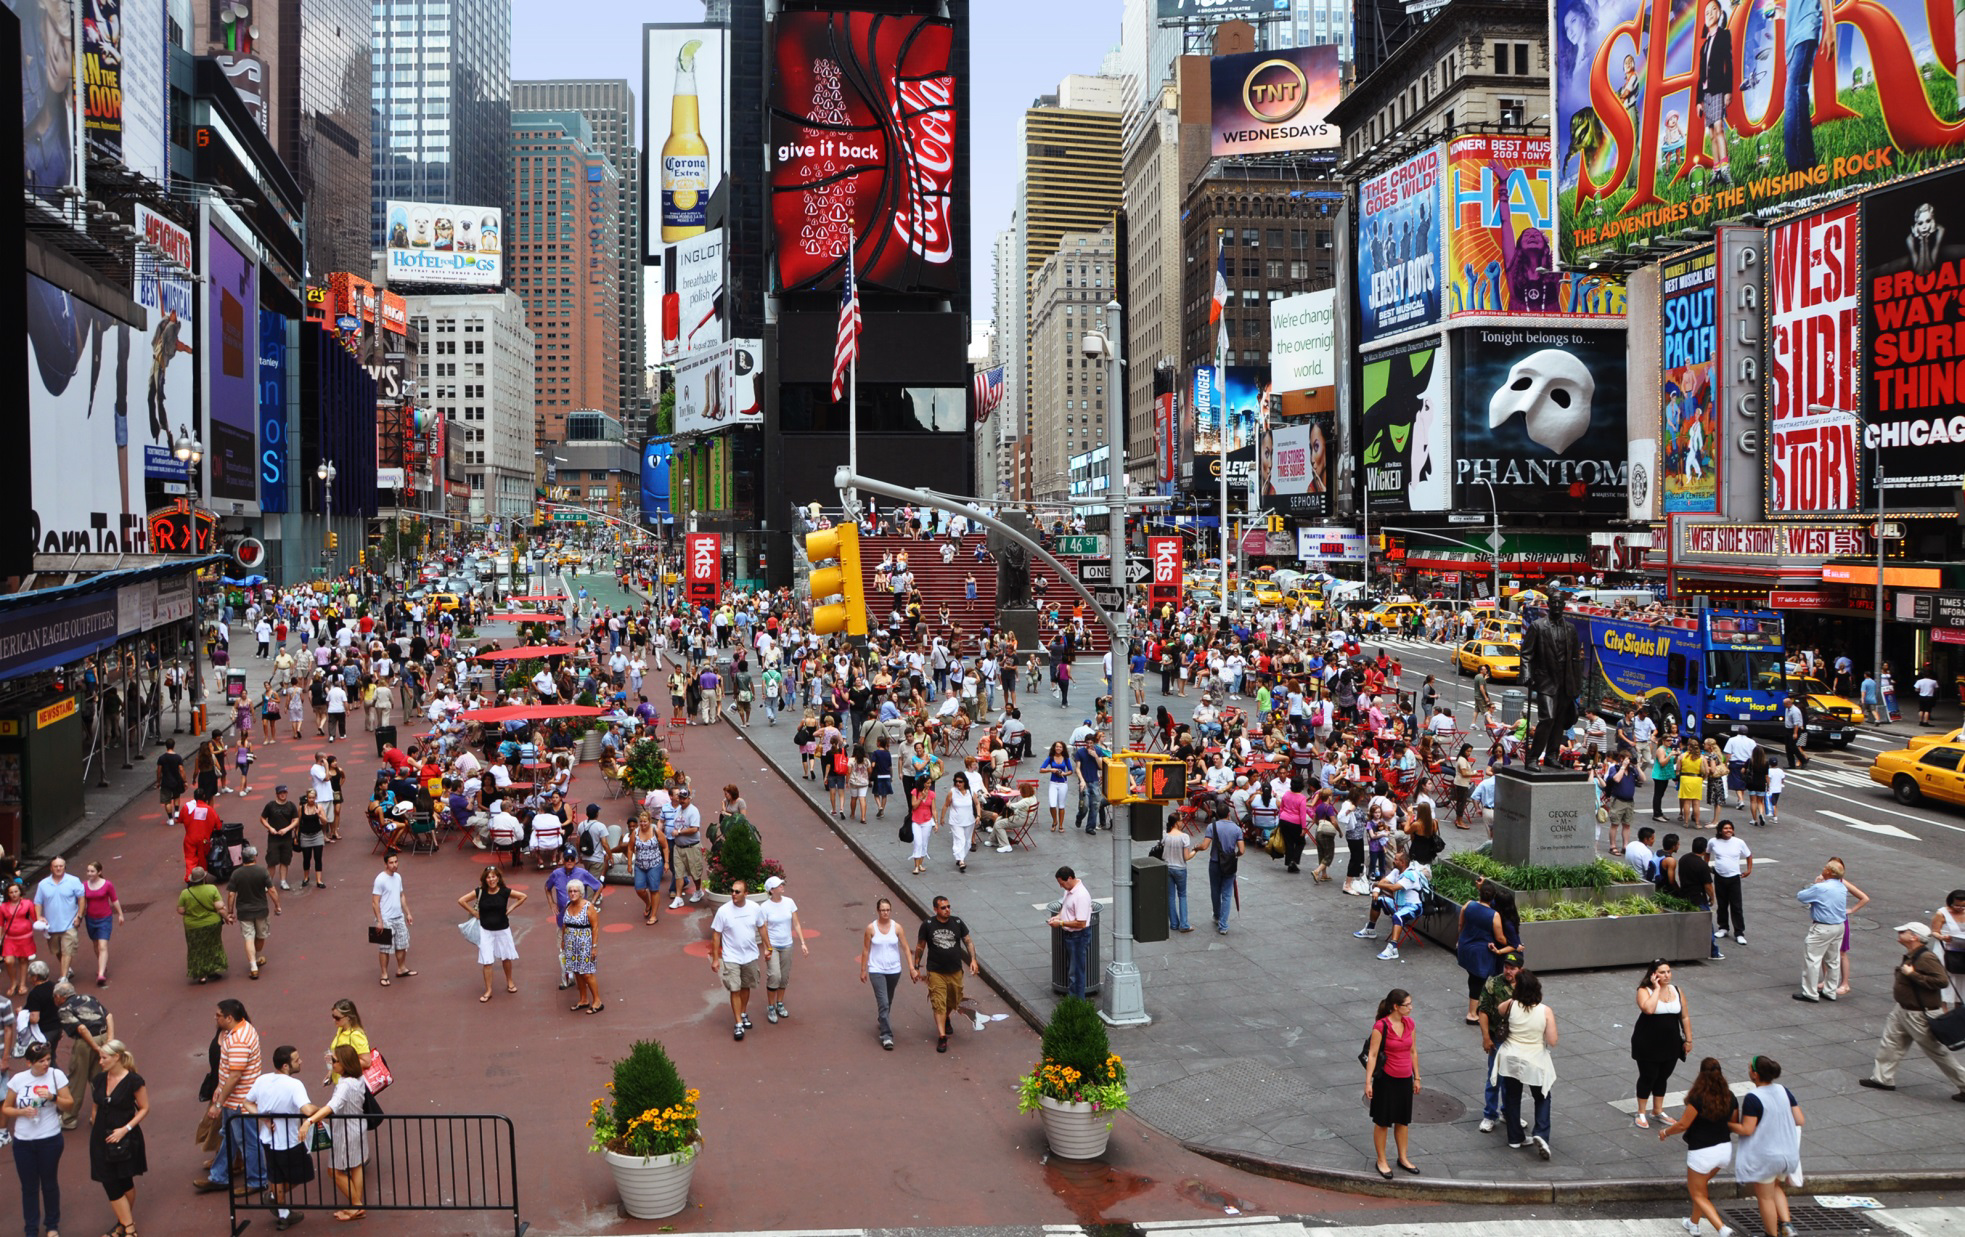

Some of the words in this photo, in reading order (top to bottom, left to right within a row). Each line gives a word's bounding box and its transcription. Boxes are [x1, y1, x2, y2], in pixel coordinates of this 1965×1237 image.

[101, 69, 118, 88] THE
[1252, 82, 1298, 104] TNT
[1223, 124, 1328, 144] WEDNESDAYS
[778, 143, 815, 161] give
[820, 139, 834, 156] it
[839, 142, 879, 160] back
[1449, 139, 1486, 157] WINNER!
[1491, 139, 1522, 151] BEST
[1493, 151, 1519, 159] 2009
[1521, 151, 1546, 160] TONY
[665, 157, 706, 172] Corona
[674, 169, 700, 177] Extra
[892, 64, 952, 263] Coca-Cola
[1390, 151, 1437, 188] CROWD
[1365, 192, 1398, 217] GOES
[1574, 226, 1597, 248] THE
[1599, 203, 1688, 241] ADVENTURES
[1691, 192, 1713, 217] OF
[1715, 187, 1744, 207] THE
[1747, 160, 1828, 200] WISHING
[1832, 147, 1893, 178] ROCK
[146, 213, 191, 271] HEIGHTS
[589, 185, 602, 284] NOVOTEL
[680, 243, 722, 266] INGLOT
[1772, 203, 1857, 317] WEST
[682, 270, 718, 290] breathable
[1369, 260, 1406, 310] JERSEY
[1408, 251, 1435, 299] BOYS
[1665, 277, 1678, 294] BEST
[1679, 270, 1704, 289] MUSICAL
[1873, 259, 1965, 302] BROA
[141, 274, 158, 309] BEST
[162, 281, 192, 322] MUSICAL
[689, 289, 710, 307] polish
[1379, 308, 1395, 320] BEST
[1396, 299, 1424, 315] MUSICAL
[1665, 287, 1715, 334] SOUT
[1273, 312, 1298, 330] We're
[692, 341, 706, 351] August
[1277, 339, 1293, 354] the
[1480, 330, 1524, 346] Tonight
[1526, 330, 1569, 346] belongs
[1737, 246, 1757, 454] PALACE
[1293, 360, 1324, 378] world.
[1772, 308, 1857, 421] SIDE
[1197, 368, 1210, 413] AVENGER
[1198, 415, 1210, 433] THE
[1277, 450, 1287, 465] TWO
[1288, 448, 1305, 464] STORES
[1277, 465, 1289, 478] TIMES
[1289, 463, 1305, 477] SQUARE
[1456, 458, 1628, 486] PHANTOM
[1772, 424, 1857, 511] STORY
[1367, 467, 1402, 491] WICKED
[1290, 495, 1320, 508] SEPHORA
[1058, 538, 1067, 553] W
[1070, 538, 1083, 552] 46
[1086, 537, 1094, 546] ST
[1321, 543, 1344, 553] GIFTS
[1691, 527, 1716, 551] WEST
[1717, 527, 1742, 552] SIDE
[1745, 527, 1774, 552] STORY
[1788, 528, 1836, 554] WEST
[694, 537, 715, 579] tkts
[1157, 540, 1178, 582] tkts
[1473, 551, 1514, 563] sbaro
[1524, 552, 1564, 563] sbarro
[1089, 567, 1110, 577] ONE
[1098, 594, 1108, 604] ONE
[1110, 594, 1121, 605] WAY
[1939, 598, 1961, 607] TIMES
[42, 620, 70, 648] EAGLE
[71, 609, 114, 638] OUTFITTERS
[1604, 629, 1655, 658] CitySights
[1656, 636, 1671, 657] NY
[1725, 694, 1741, 704] Hop
[1750, 703, 1765, 712] Hop
[1766, 703, 1777, 711] off
[39, 699, 73, 724] NEWSSTAND
[1548, 810, 1578, 818] GEORGE
[24, 1085, 31, 1094] I
